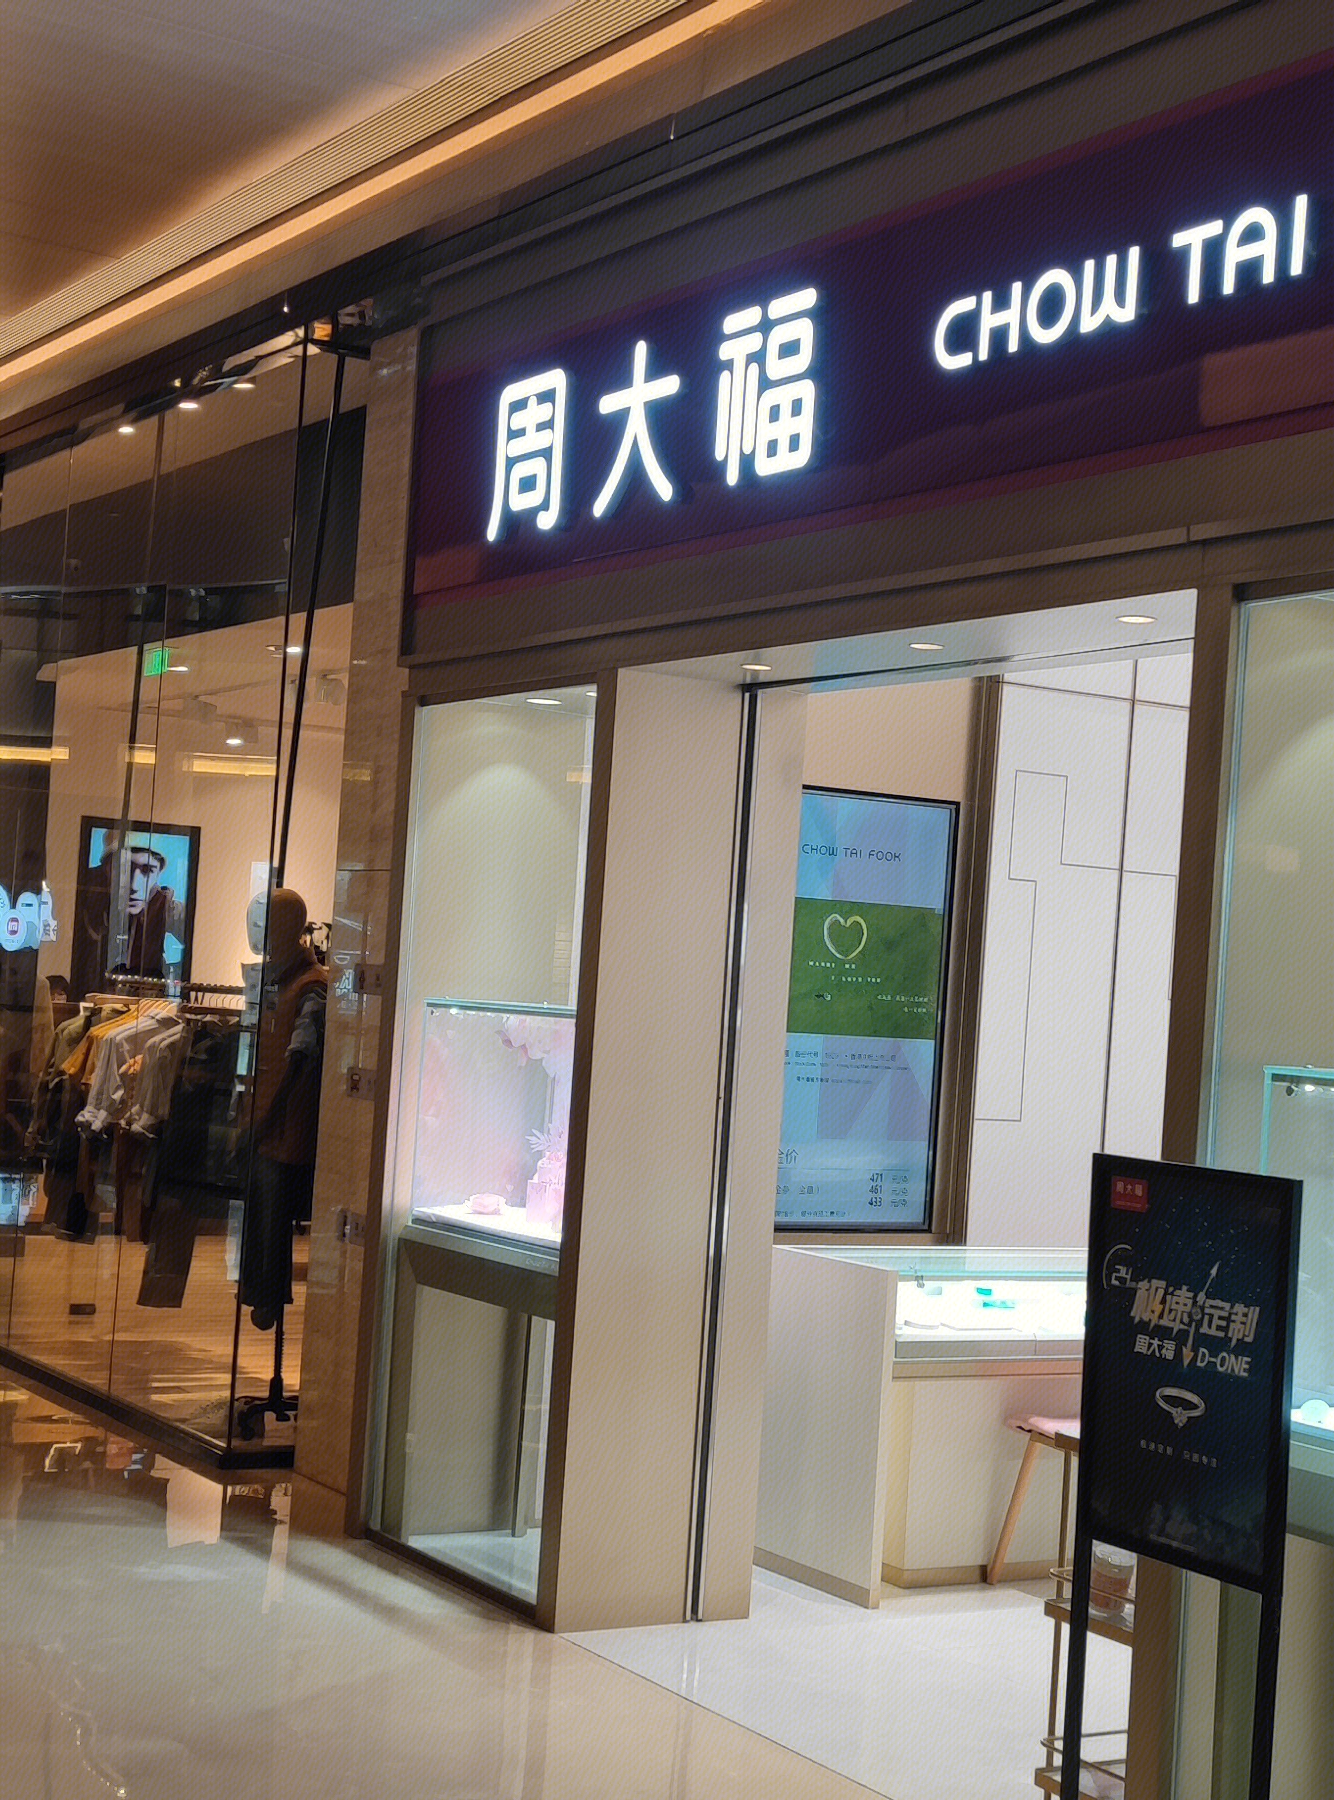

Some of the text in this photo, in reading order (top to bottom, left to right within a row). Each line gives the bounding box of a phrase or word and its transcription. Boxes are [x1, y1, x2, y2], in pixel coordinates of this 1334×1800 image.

[932, 244, 1141, 372] CHOW
[1170, 192, 1309, 306] TAI
[485, 286, 819, 543] 周大福
[801, 843, 902, 862] CHOW TAI FOOK
[1133, 1333, 1252, 1377] 周大福 D-ONE
